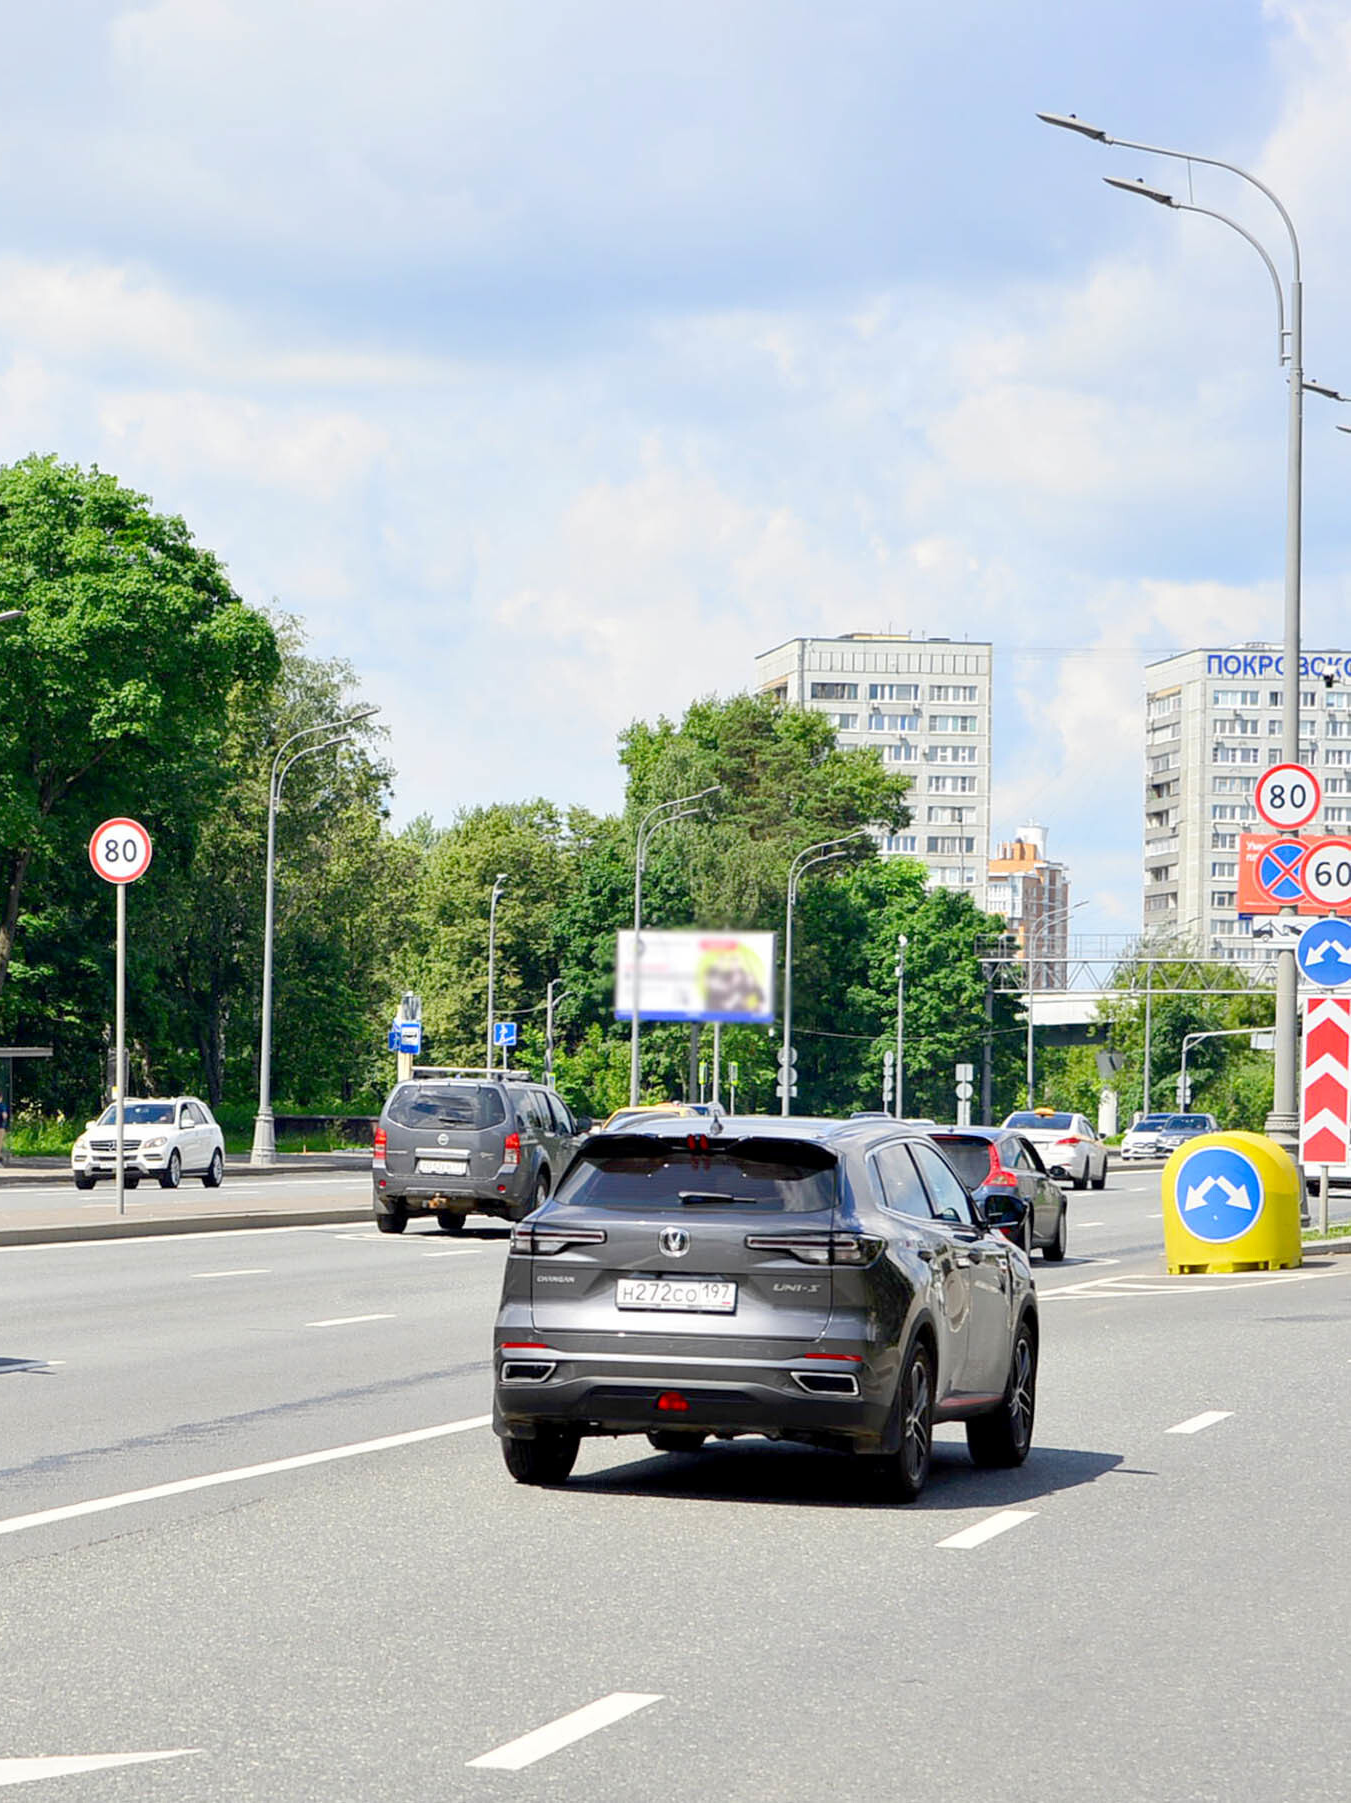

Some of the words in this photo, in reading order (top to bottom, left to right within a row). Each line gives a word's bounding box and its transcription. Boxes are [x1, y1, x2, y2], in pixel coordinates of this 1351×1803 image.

[1269, 784, 1306, 809] 80
[105, 839, 137, 862] 80
[1315, 861, 1351, 887] 60
